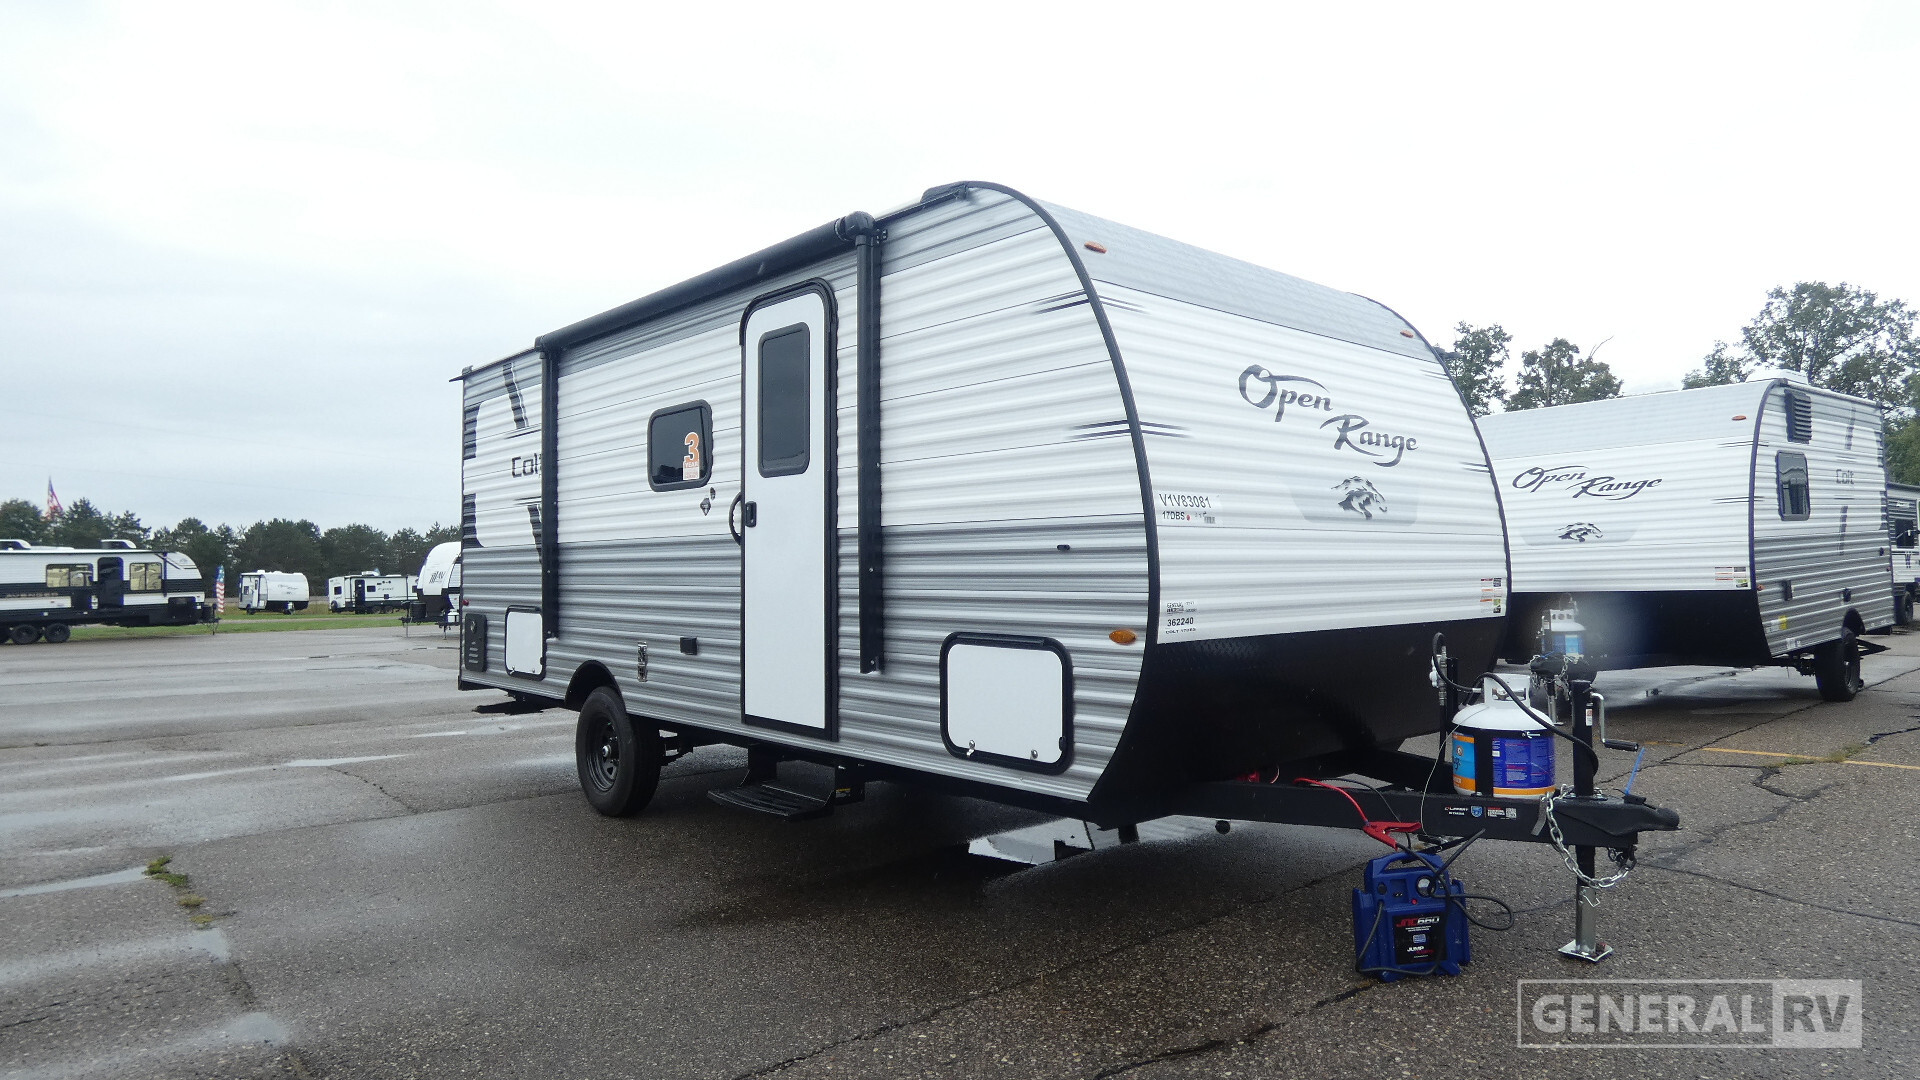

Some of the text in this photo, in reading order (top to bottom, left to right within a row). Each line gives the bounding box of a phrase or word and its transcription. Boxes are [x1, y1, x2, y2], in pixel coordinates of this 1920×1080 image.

[1238, 364, 1333, 422] Open
[683, 431, 700, 462] 3
[1319, 414, 1418, 467] Range
[511, 452, 542, 478] Col
[1512, 465, 1662, 500] Open Range
[1159, 493, 1211, 508] V1V83081
[1162, 510, 1185, 520] 17DBS
[1167, 616, 1194, 627] 362240
